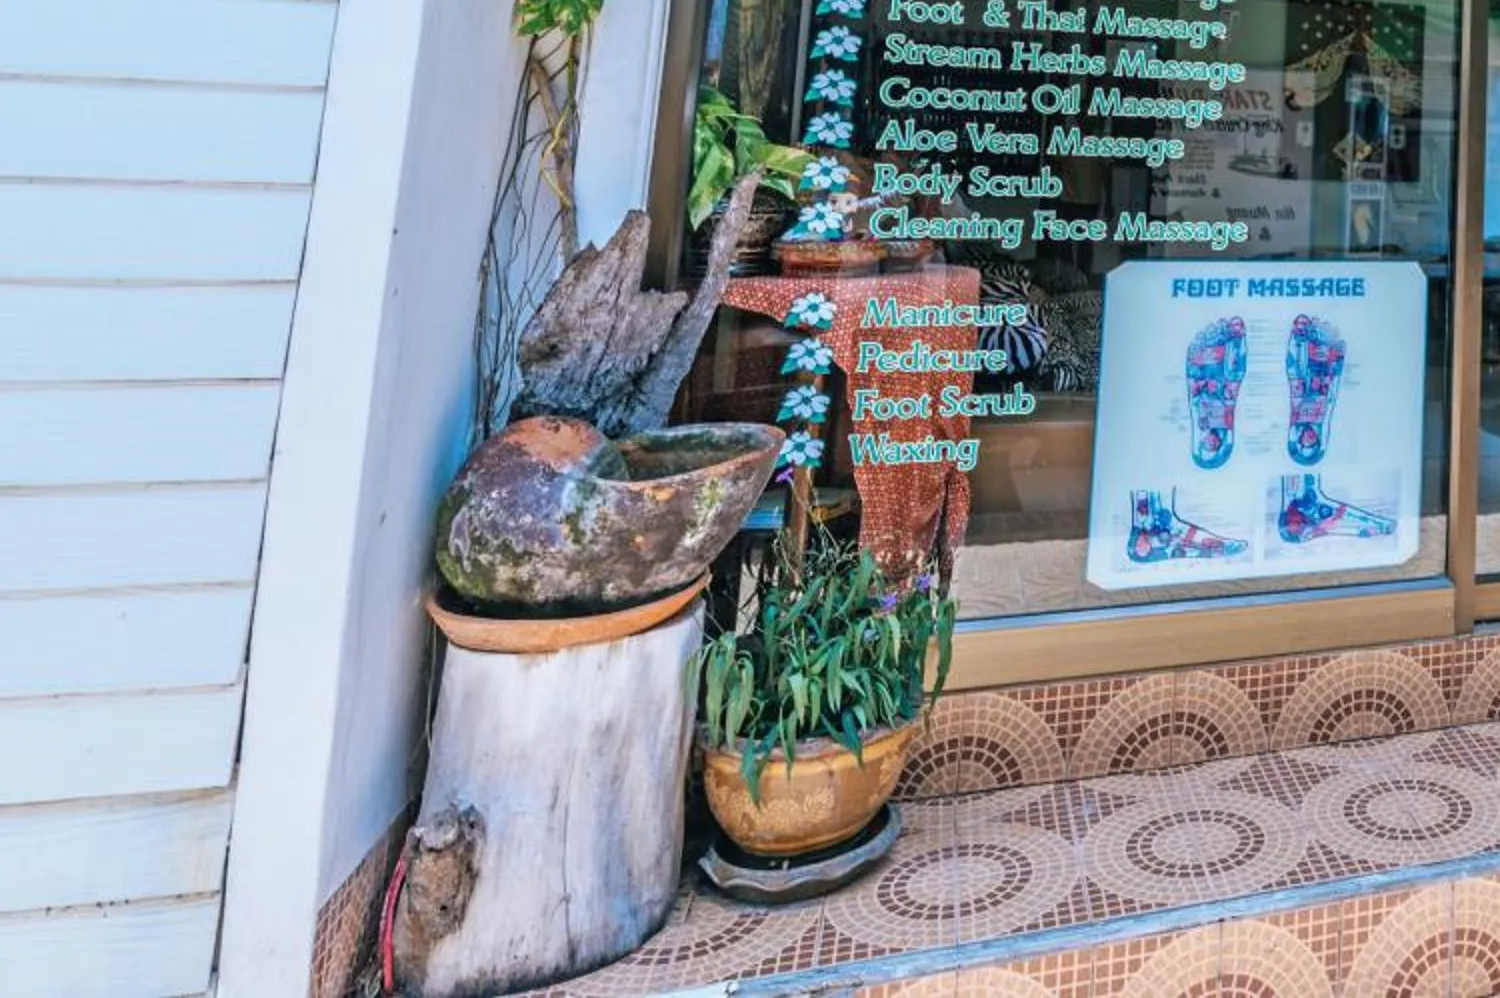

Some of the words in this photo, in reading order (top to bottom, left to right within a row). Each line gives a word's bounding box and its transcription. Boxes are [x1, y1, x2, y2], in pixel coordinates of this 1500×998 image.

[1017, 0, 1087, 33] Thai
[1093, 7, 1227, 48] Massage
[884, 33, 1001, 69] Stream
[1010, 42, 1105, 76] Herbs
[1114, 49, 1246, 90] Massage
[879, 77, 1027, 113] Coconut
[1032, 84, 1080, 115] Oil
[1088, 89, 1222, 129] Massage
[875, 120, 957, 152] Aloe
[966, 123, 1039, 155] Vera
[1046, 125, 1184, 167] Massage
[872, 164, 963, 204] Body
[968, 166, 1062, 197] Scrub
[869, 206, 1024, 248] Cleaning
[1032, 210, 1107, 241] Face
[1113, 212, 1248, 250] Massage
[1171, 277, 1241, 298] FOOT
[1247, 276, 1366, 298] MASSAGE
[860, 297, 1027, 328] Manicure
[855, 339, 1007, 373] Pedicure
[852, 389, 932, 420] Foot
[940, 381, 1036, 417] Scrub
[848, 433, 980, 471] Waxing
